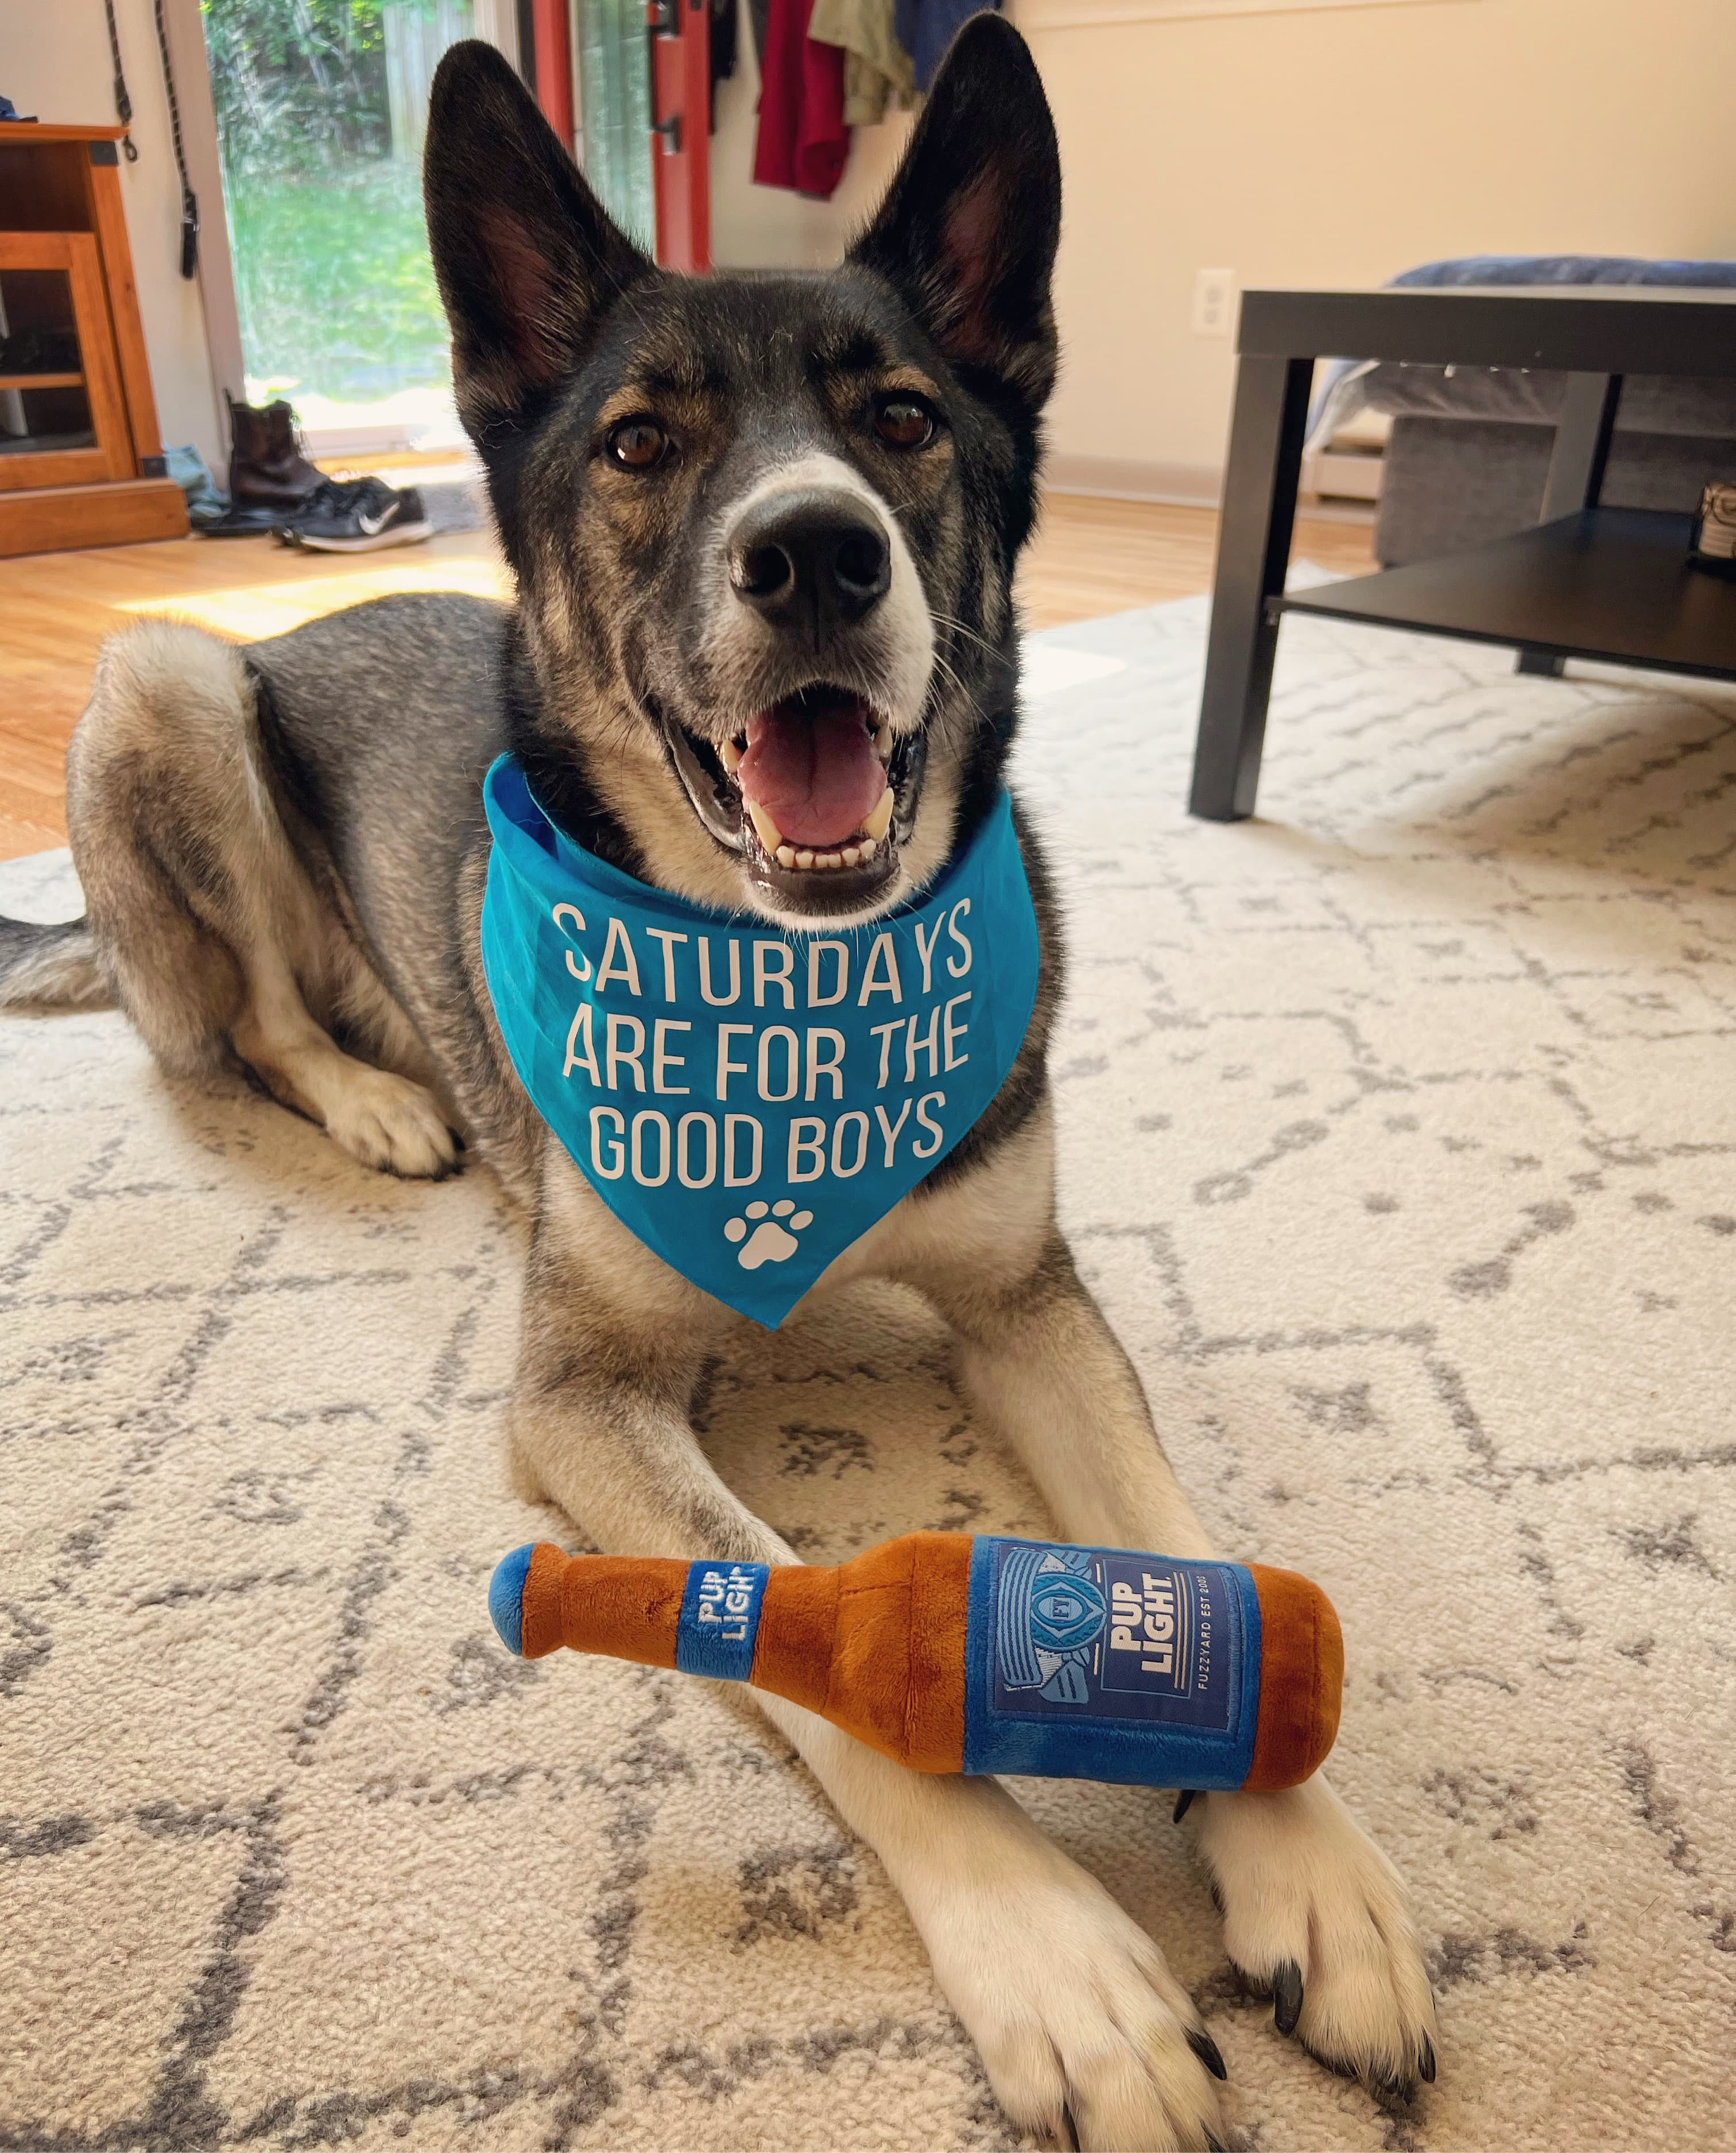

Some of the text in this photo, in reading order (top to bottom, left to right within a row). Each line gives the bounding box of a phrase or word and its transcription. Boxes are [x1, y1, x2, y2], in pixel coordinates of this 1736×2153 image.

[552, 898, 972, 1010] SATURDAYS
[563, 991, 973, 1101] ARE FOR THE
[589, 1091, 946, 1189] GOOD BOYS
[698, 1571, 728, 1623] PUP
[1110, 1582, 1142, 1651] PUP
[1200, 1596, 1211, 1617] EST
[1198, 1622, 1211, 1689] FUZZYARD
